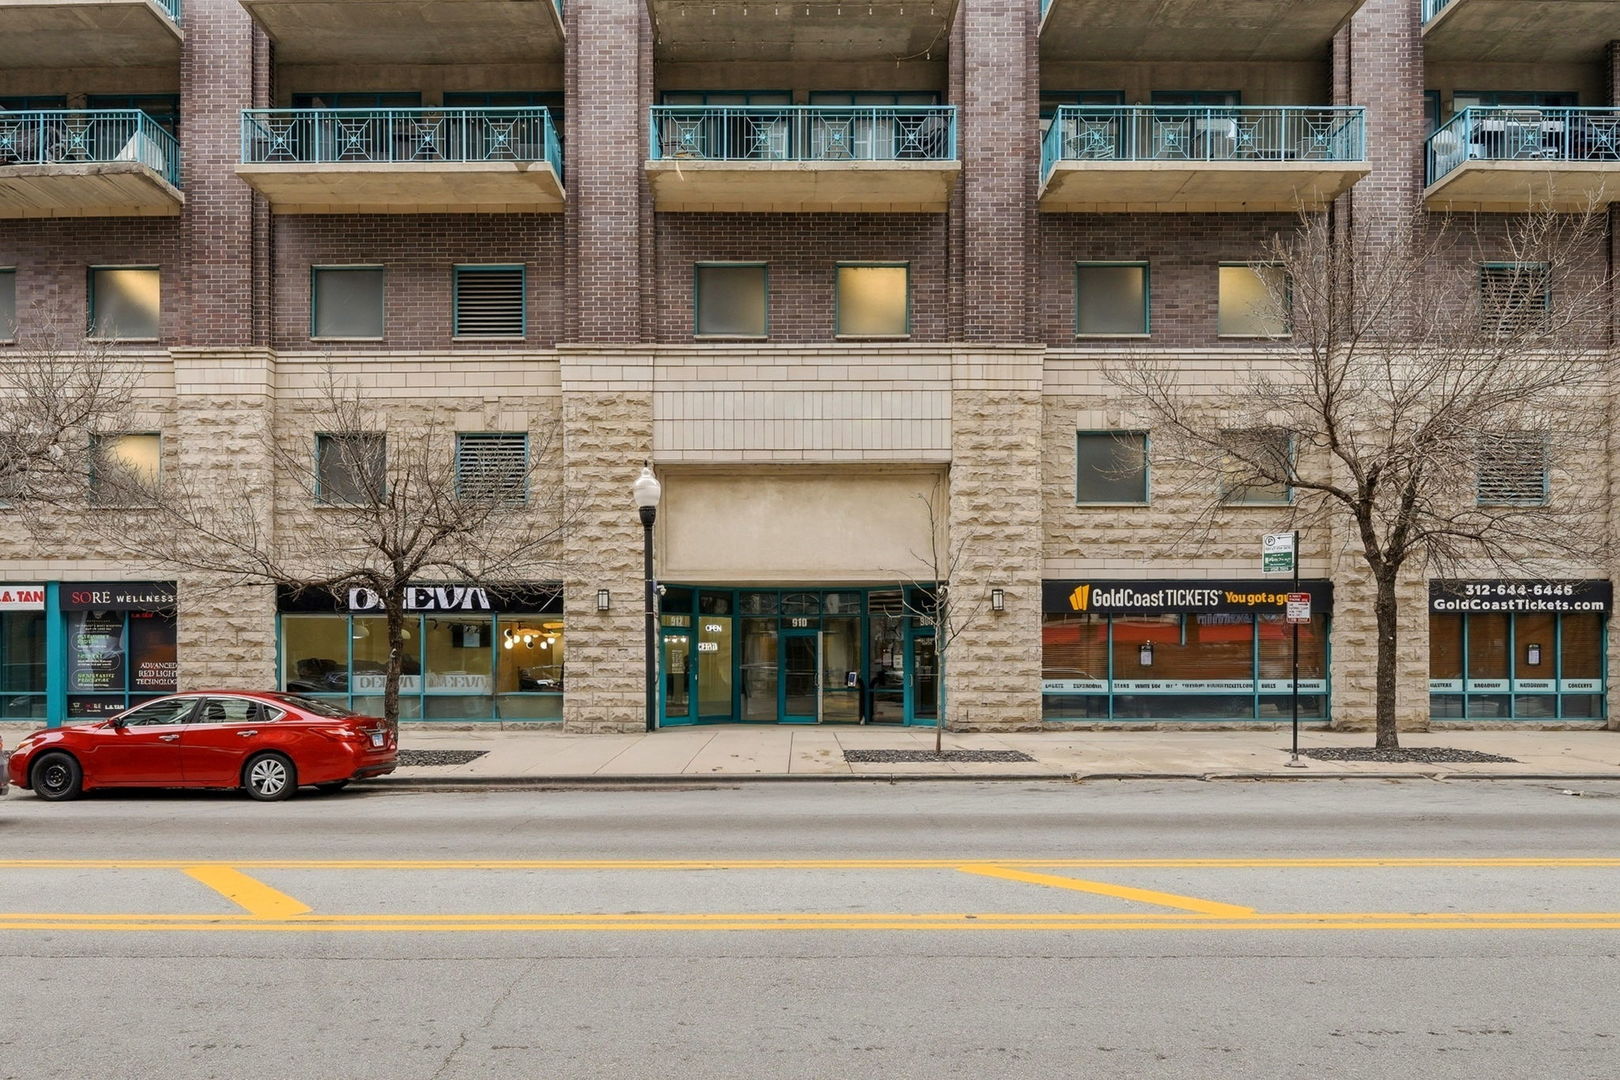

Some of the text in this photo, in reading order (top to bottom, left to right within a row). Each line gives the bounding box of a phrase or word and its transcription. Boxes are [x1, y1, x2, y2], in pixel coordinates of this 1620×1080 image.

[1465, 584, 1573, 596] 312-644-6446
[17, 591, 44, 602] TAN
[71, 591, 174, 604] SORE WELLNESS
[1092, 588, 1164, 607] GoldCoast
[1224, 591, 1246, 603] You
[1247, 592, 1268, 606] got
[1268, 594, 1275, 603] a
[1433, 599, 1604, 610] GoldCoastTickets.com
[705, 624, 722, 632] OPEN
[792, 617, 807, 628] 910
[138, 670, 155, 678] RED
